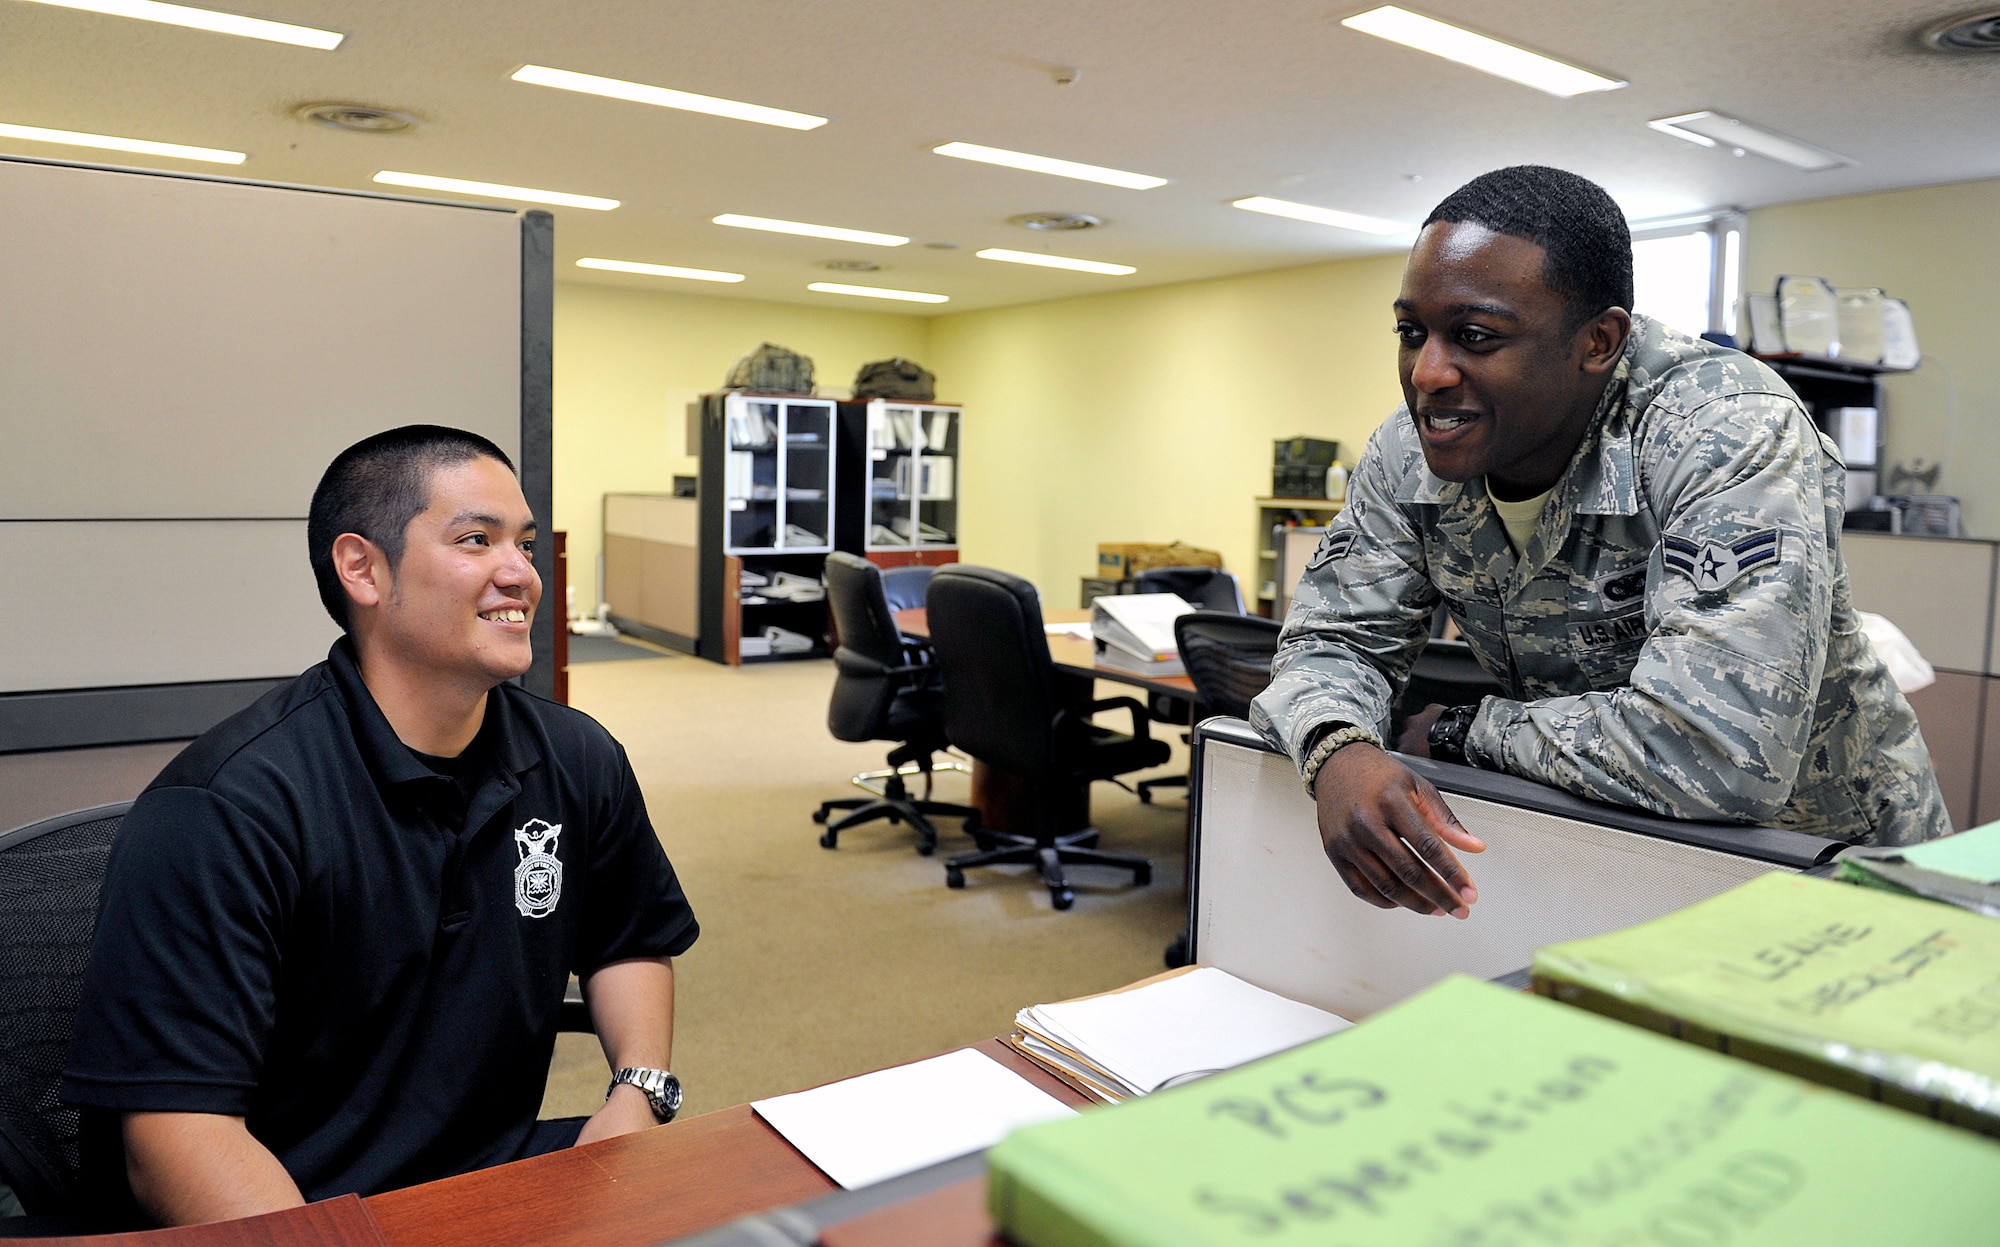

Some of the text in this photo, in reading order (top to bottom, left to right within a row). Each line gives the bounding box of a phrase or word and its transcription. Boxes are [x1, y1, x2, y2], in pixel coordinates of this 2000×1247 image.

[1578, 616, 1646, 646] U.S. AIR
[1207, 1070, 1390, 1142] PCS
